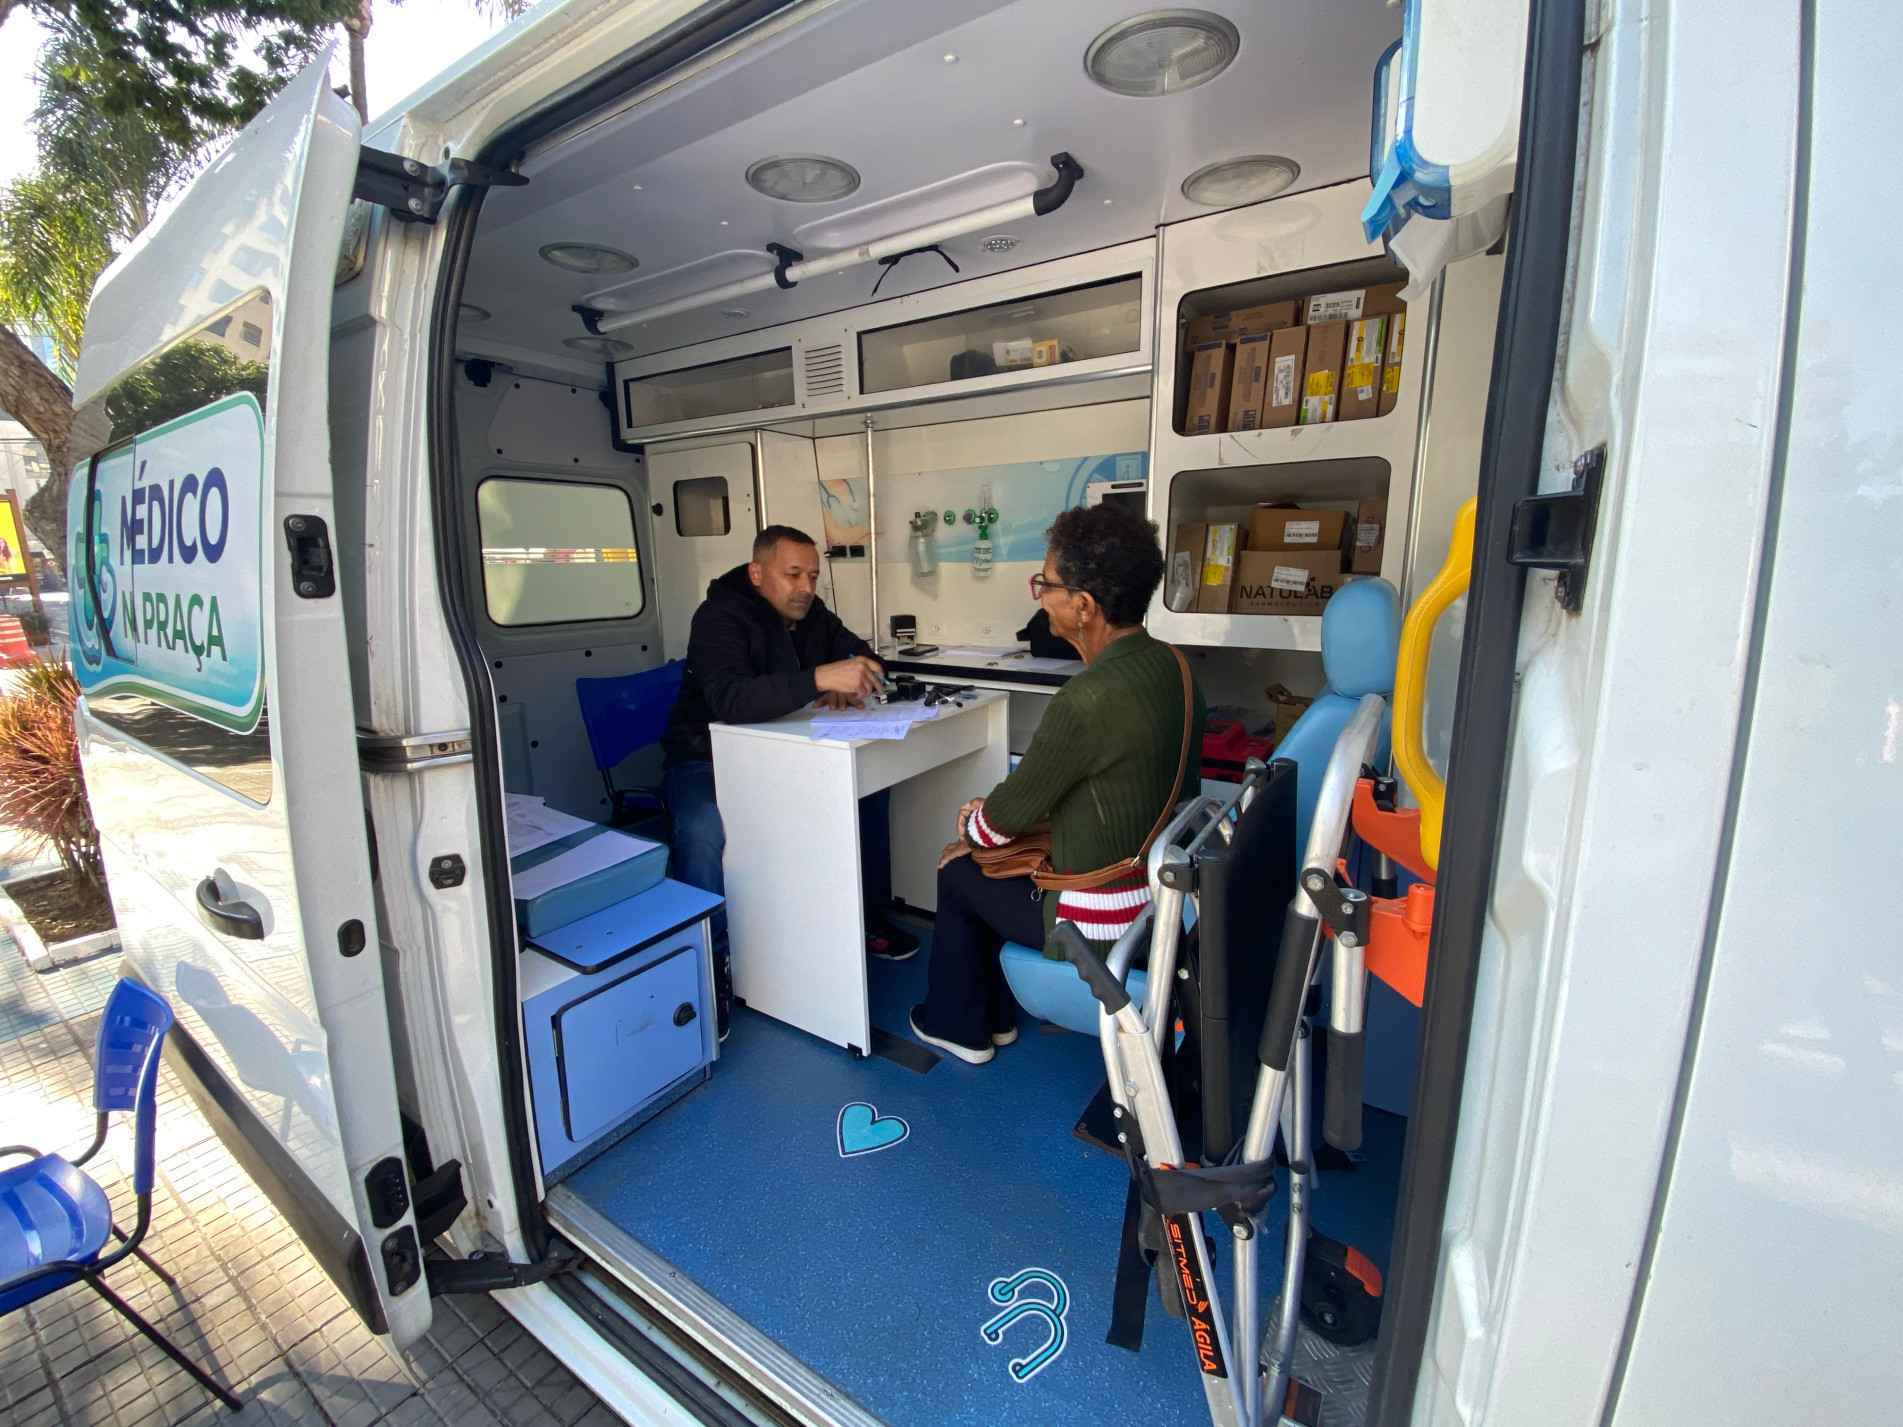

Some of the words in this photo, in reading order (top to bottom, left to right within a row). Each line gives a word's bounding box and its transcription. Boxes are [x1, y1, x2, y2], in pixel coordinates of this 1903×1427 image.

[120, 460, 229, 566] MÉDICO
[142, 591, 228, 672] PRAÇA
[1169, 1222, 1198, 1305] SITMED
